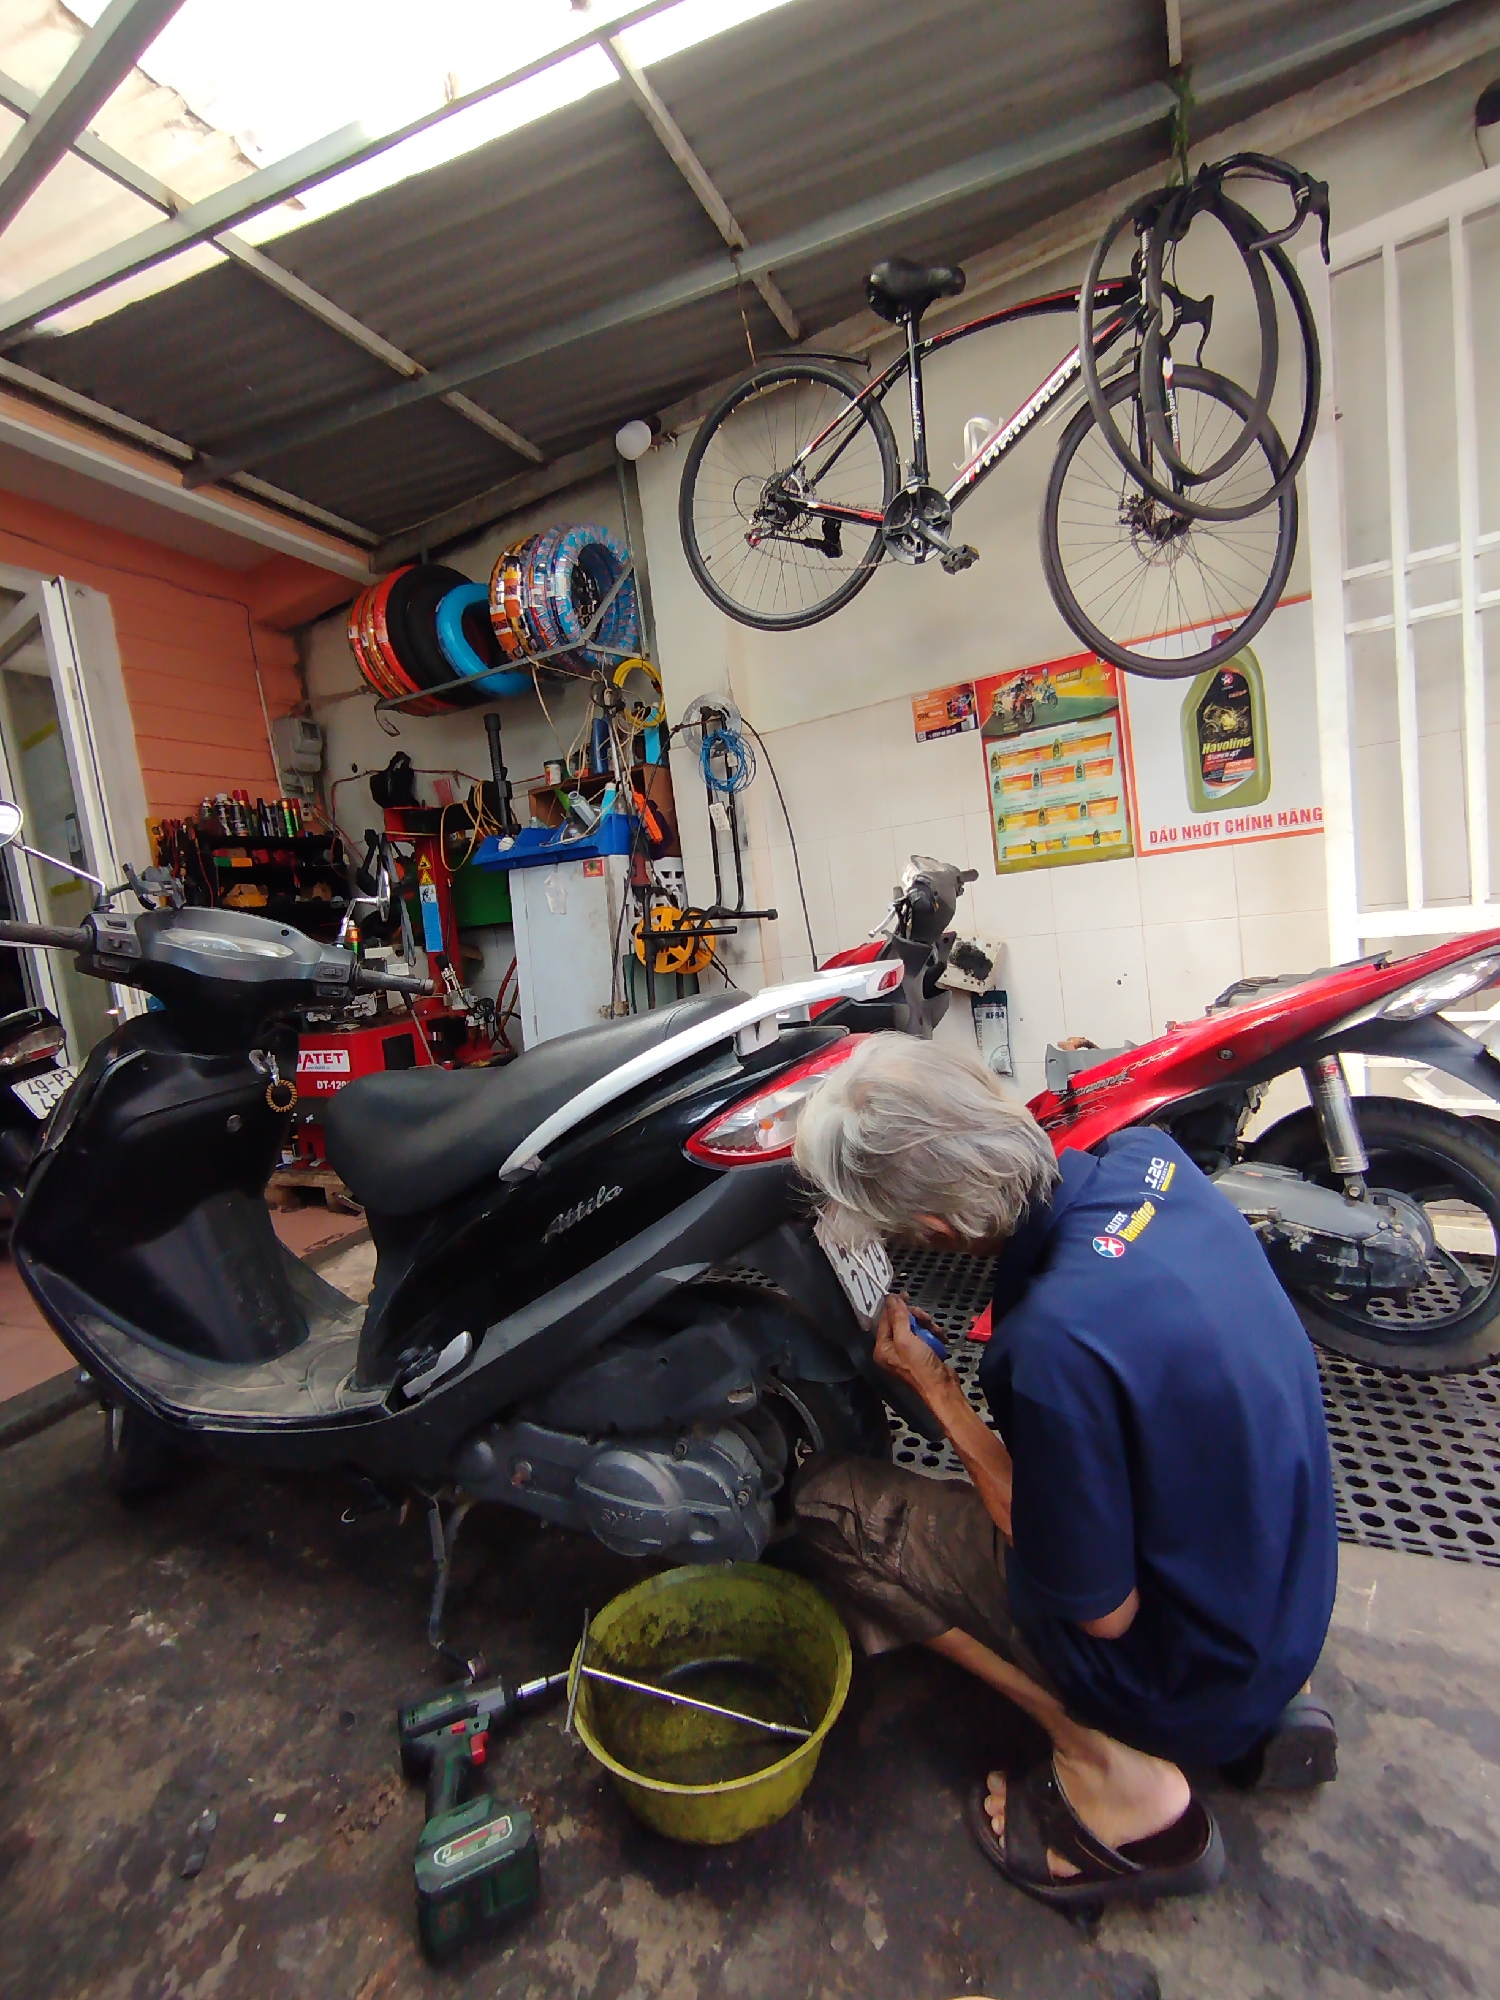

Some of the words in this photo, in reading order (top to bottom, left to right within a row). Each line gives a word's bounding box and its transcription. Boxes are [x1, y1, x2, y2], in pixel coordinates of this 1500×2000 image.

[1202, 737, 1252, 755] Havoline
[1181, 820, 1221, 841] NHỚT
[1224, 813, 1273, 834] CHÍNH
[1277, 806, 1323, 827] HÃNG
[1144, 1156, 1165, 1189] 120
[540, 1184, 624, 1243] Attila
[1104, 1210, 1129, 1234] CALTEX
[1116, 1200, 1156, 1242] Havoline
